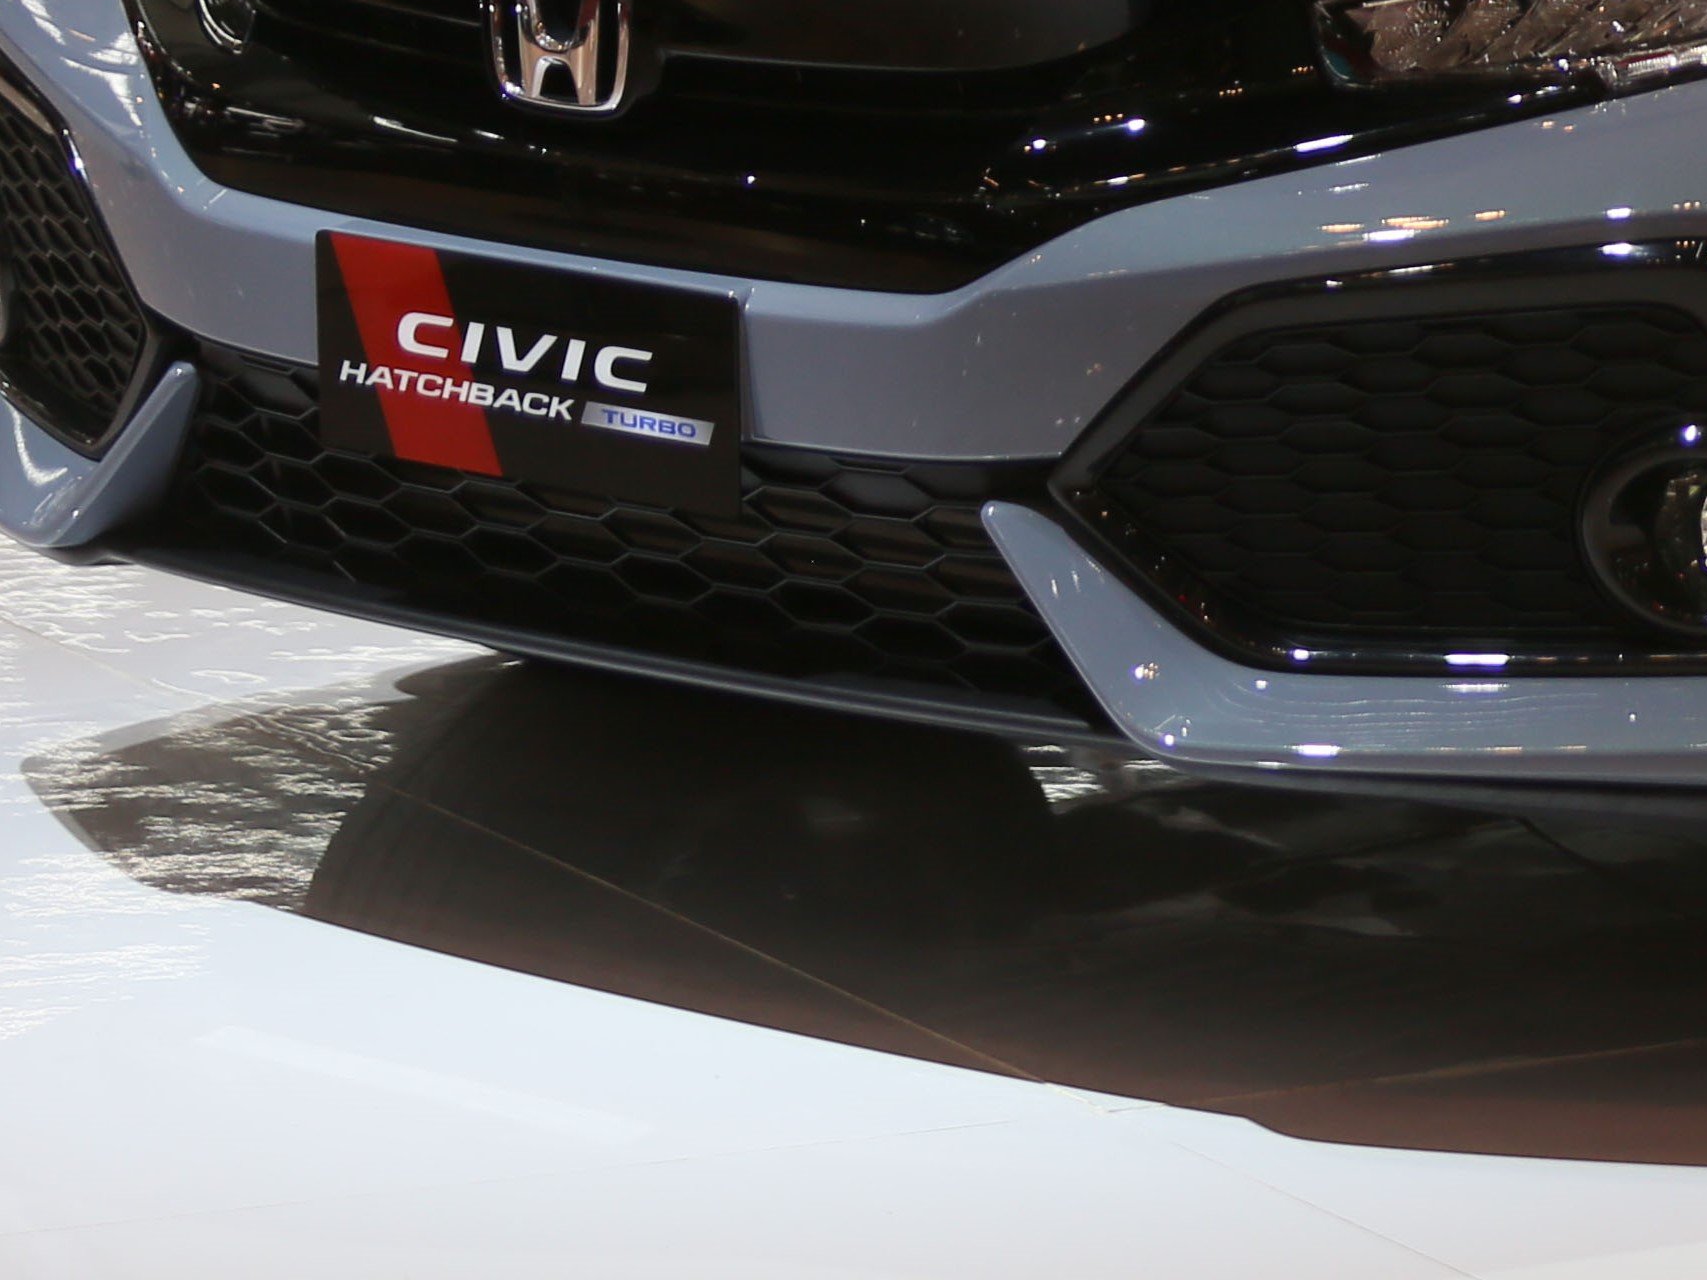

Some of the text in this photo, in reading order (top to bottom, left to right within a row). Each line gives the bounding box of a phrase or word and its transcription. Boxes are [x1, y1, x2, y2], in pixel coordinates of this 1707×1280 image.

[397, 311, 653, 394] CIVIC
[338, 359, 697, 439] HATCHBACK TURBO
